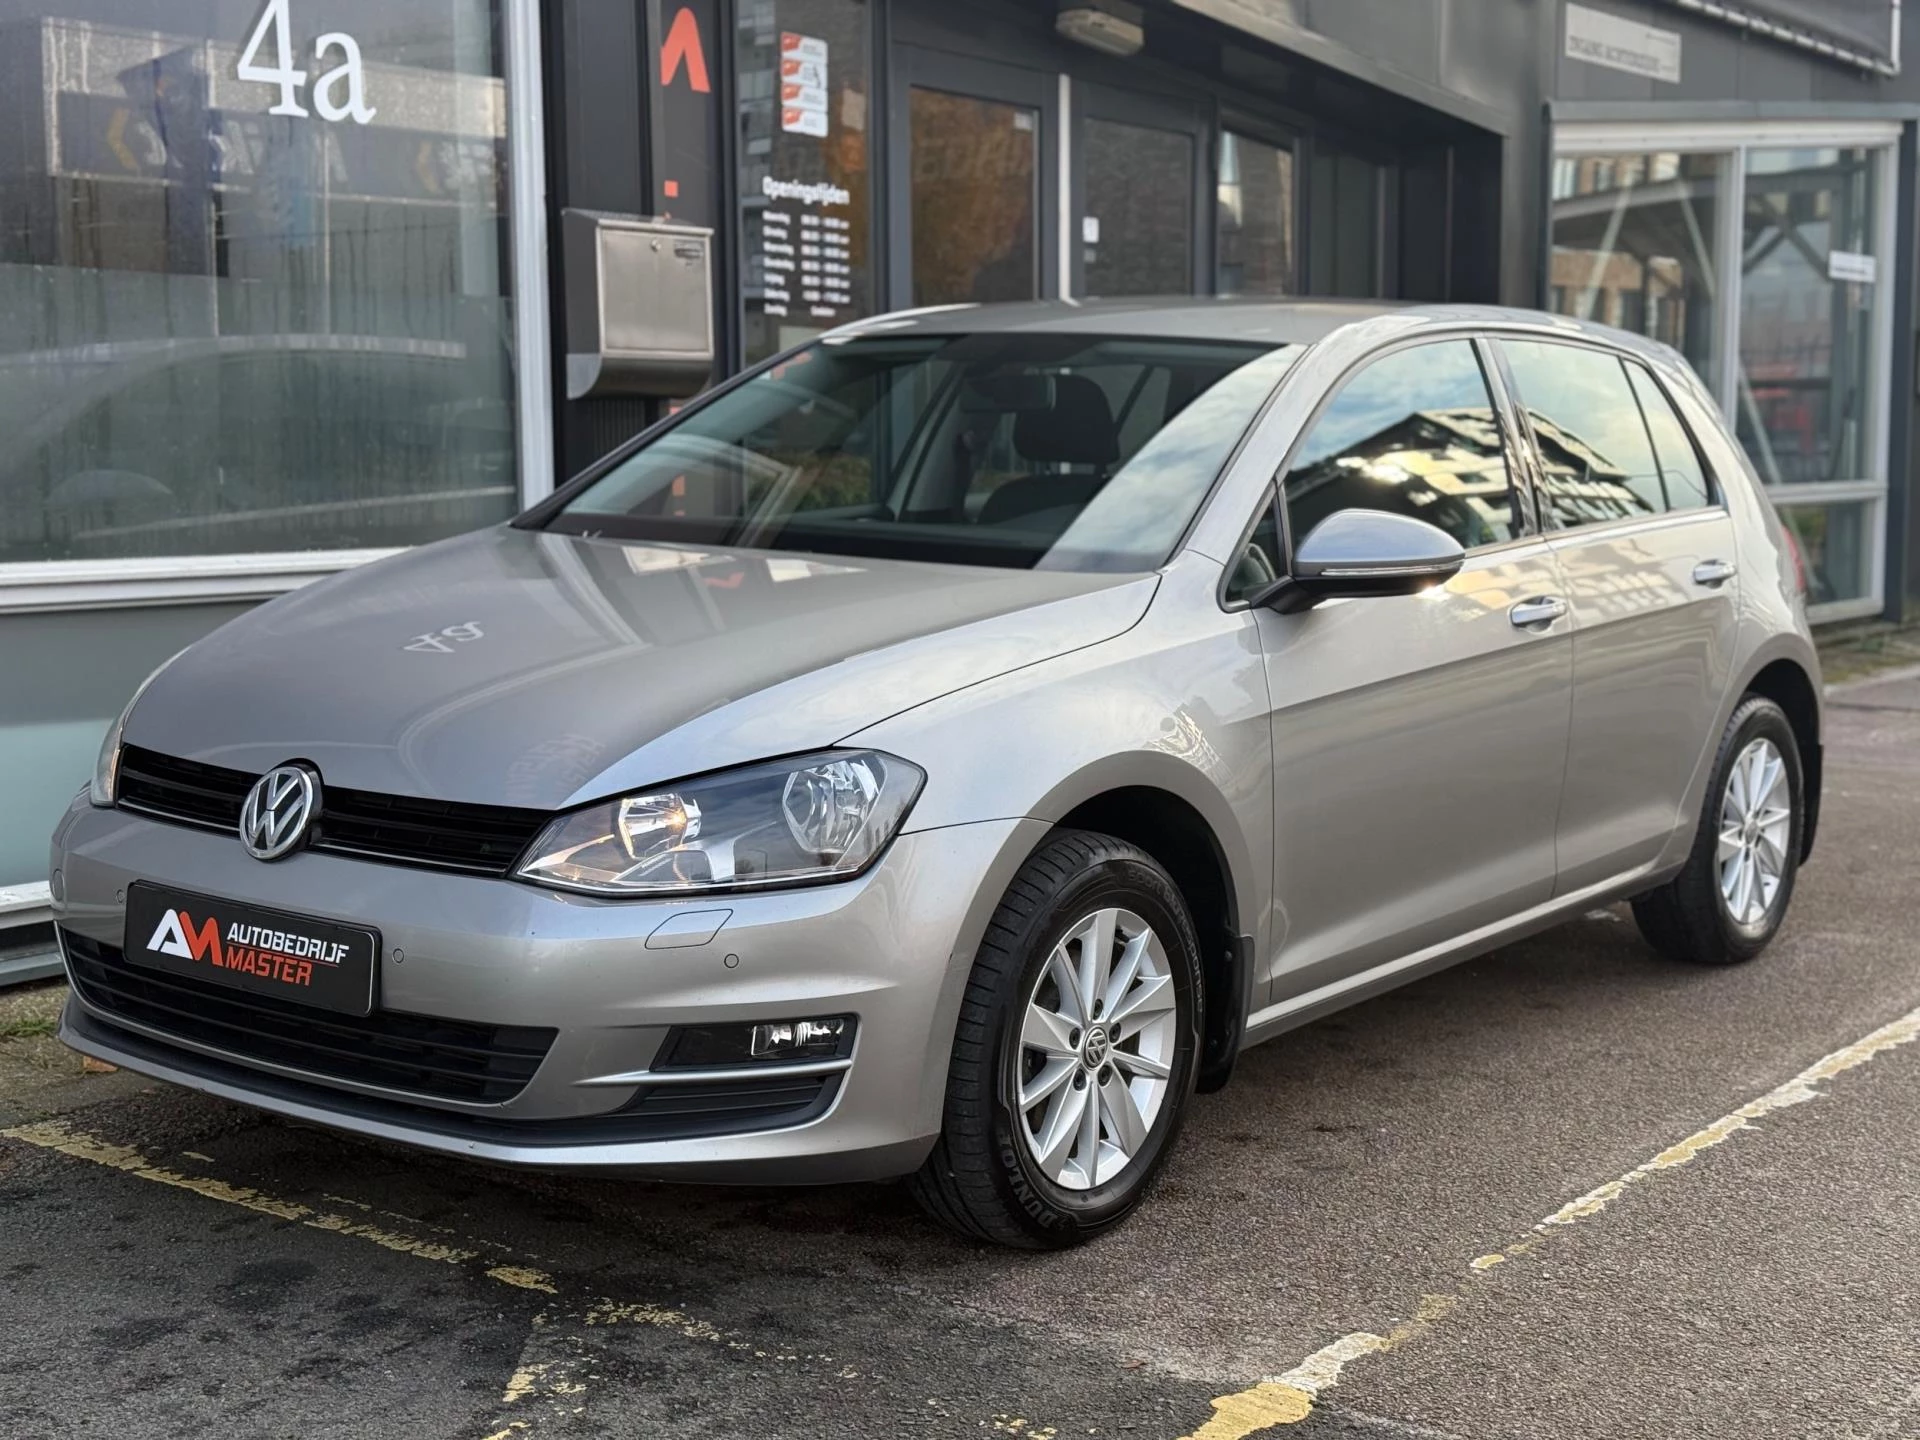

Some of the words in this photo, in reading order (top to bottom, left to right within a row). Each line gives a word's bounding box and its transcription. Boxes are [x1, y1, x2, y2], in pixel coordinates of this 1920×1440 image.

[237, 0, 377, 125] 4a
[227, 922, 350, 964] AUTOBEDRIJF
[225, 946, 313, 987] MASTER
